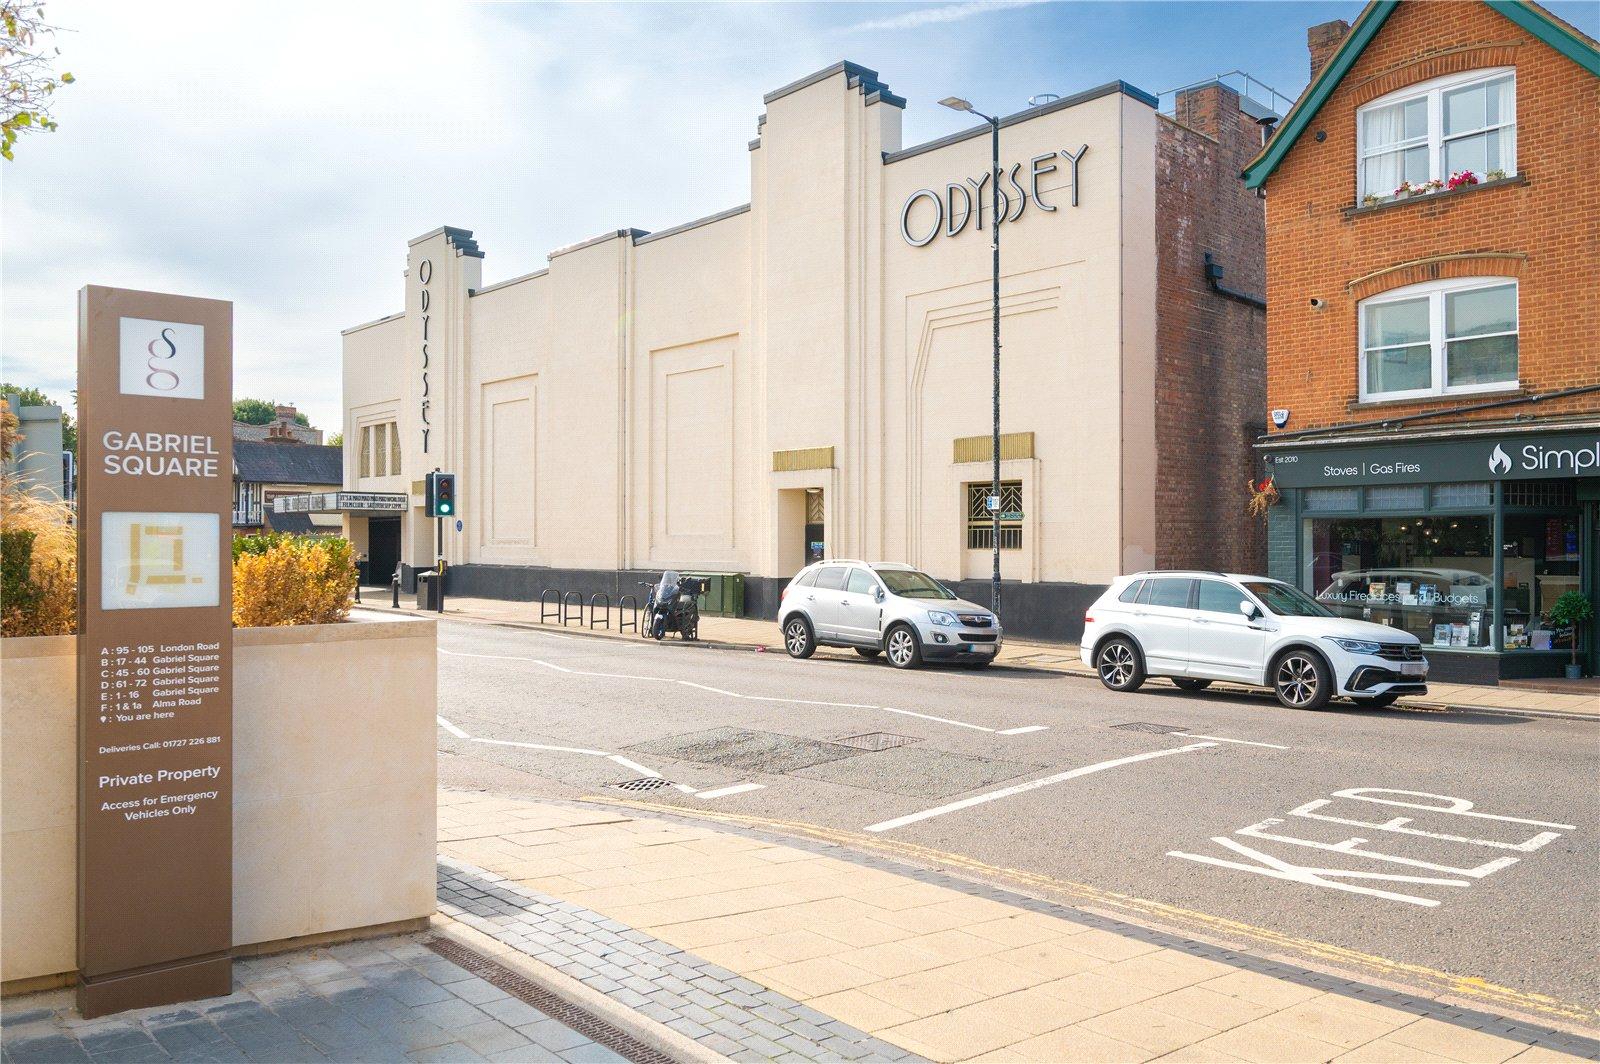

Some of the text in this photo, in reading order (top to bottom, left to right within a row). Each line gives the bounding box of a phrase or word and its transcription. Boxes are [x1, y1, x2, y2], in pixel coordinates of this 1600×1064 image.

[900, 143, 1090, 248] ODYSSEY
[420, 258, 432, 454] ODYSSEY
[102, 430, 219, 455] GABRIEL
[104, 454, 218, 477] SQUARE
[1522, 442, 1600, 474] Simpl
[1324, 462, 1420, 476] Stoves Gas Fires
[1316, 590, 1347, 602] Luxury
[1434, 593, 1478, 605] Budgets
[160, 644, 194, 652] London
[197, 642, 219, 650] Road
[188, 654, 219, 662] Square
[153, 667, 185, 675] Gabriel
[188, 665, 219, 673] Square
[188, 676, 219, 684] Square
[188, 686, 219, 695] Square
[99, 744, 140, 754] Deliveries
[163, 740, 186, 748] 01727
[99, 766, 220, 788] Private Property
[101, 790, 218, 811] Access for Emergency
[125, 805, 196, 820] Vehicles Only
[1165, 786, 1577, 908] KEEP
